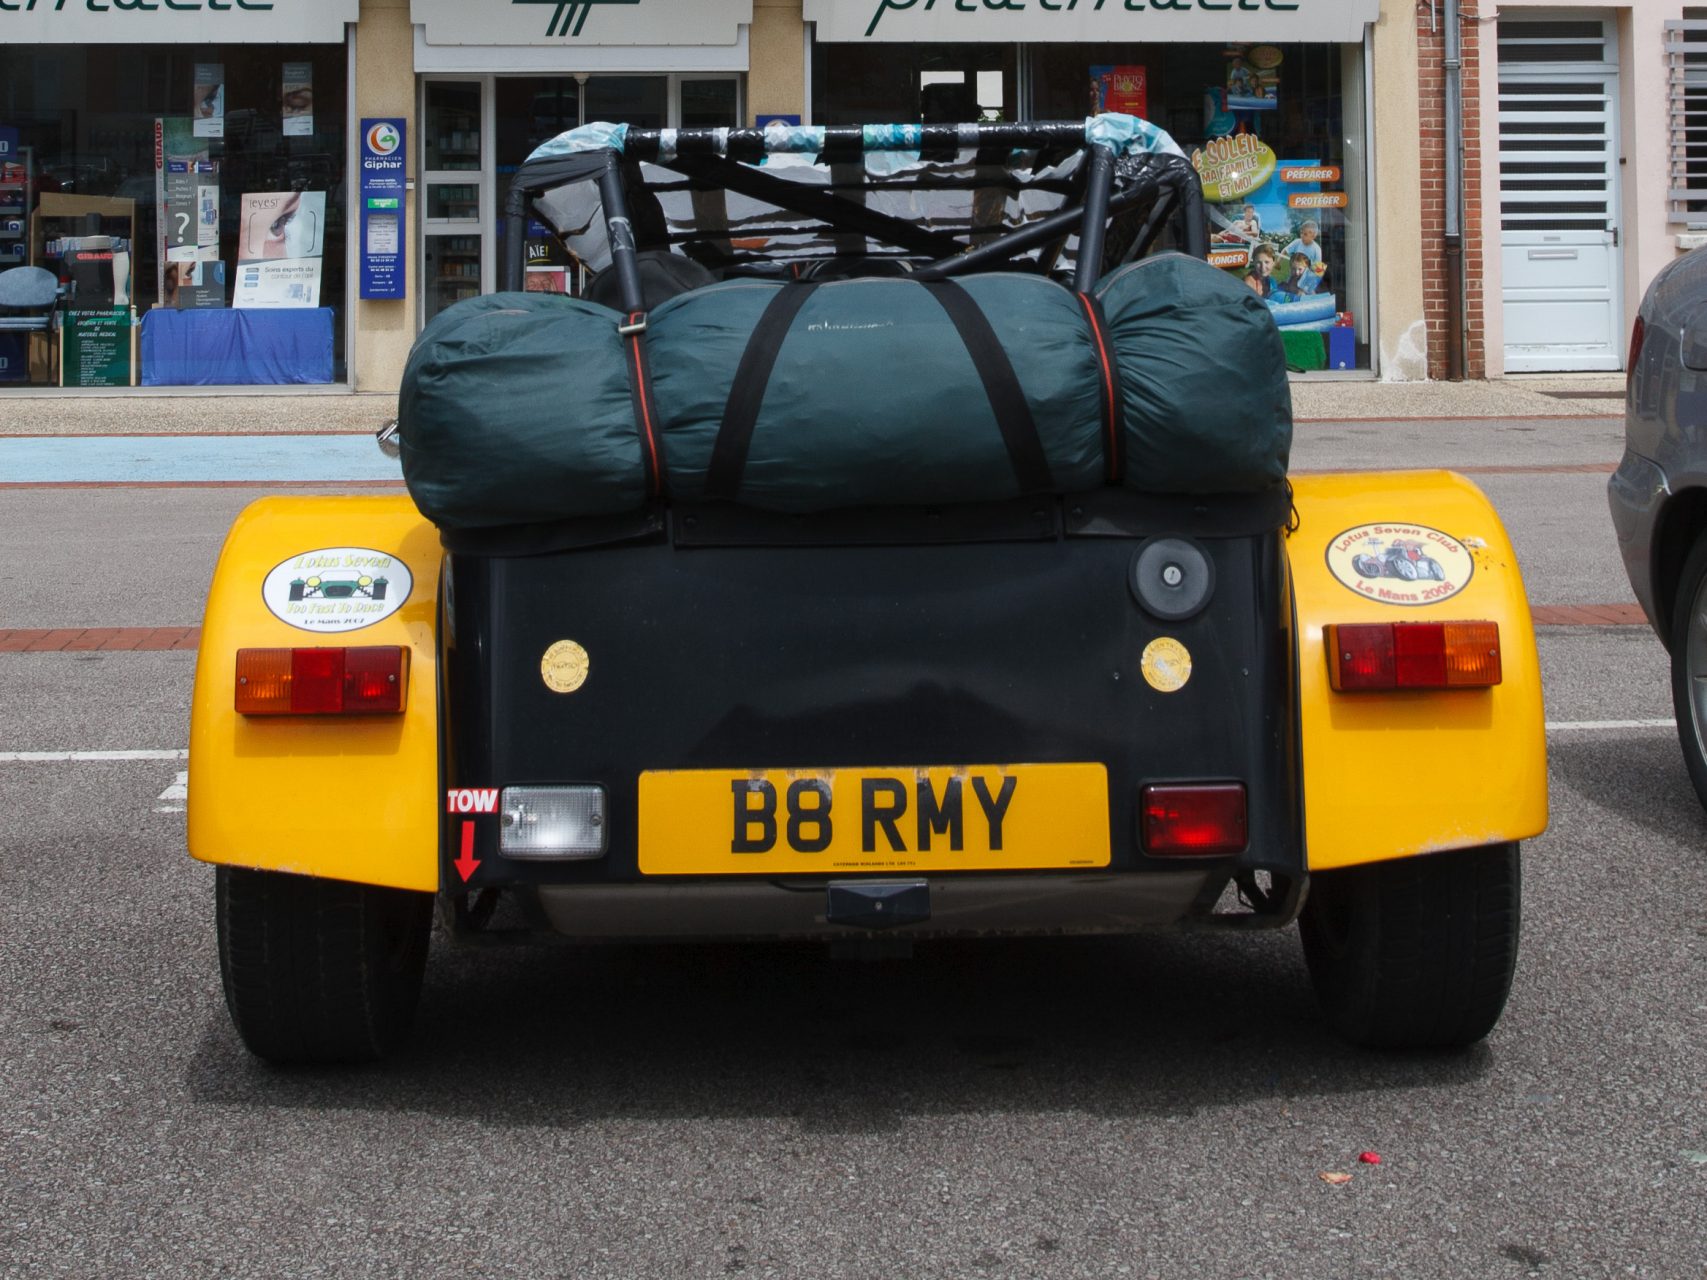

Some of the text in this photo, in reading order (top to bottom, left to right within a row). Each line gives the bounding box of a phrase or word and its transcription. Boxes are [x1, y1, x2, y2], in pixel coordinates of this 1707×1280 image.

[1206, 133, 1267, 166] SOLEIL,
[364, 160, 402, 170] Giphar
[1201, 155, 1257, 184] MA FAMILLE
[1286, 167, 1333, 180] PRÉPARER
[1219, 175, 1252, 197] ET MOI
[1295, 193, 1340, 205] PROTÉGER
[175, 212, 190, 243] ?
[1208, 254, 1244, 266] LONGER
[1335, 530, 1369, 553] Lotus
[1373, 526, 1421, 536] Seven
[1425, 532, 1459, 554] Club
[294, 553, 392, 569] Lotus Seven
[1356, 580, 1374, 594] Le
[1378, 588, 1418, 601] Mans
[447, 788, 498, 813] TOW
[730, 776, 1018, 854] B8 RMY
